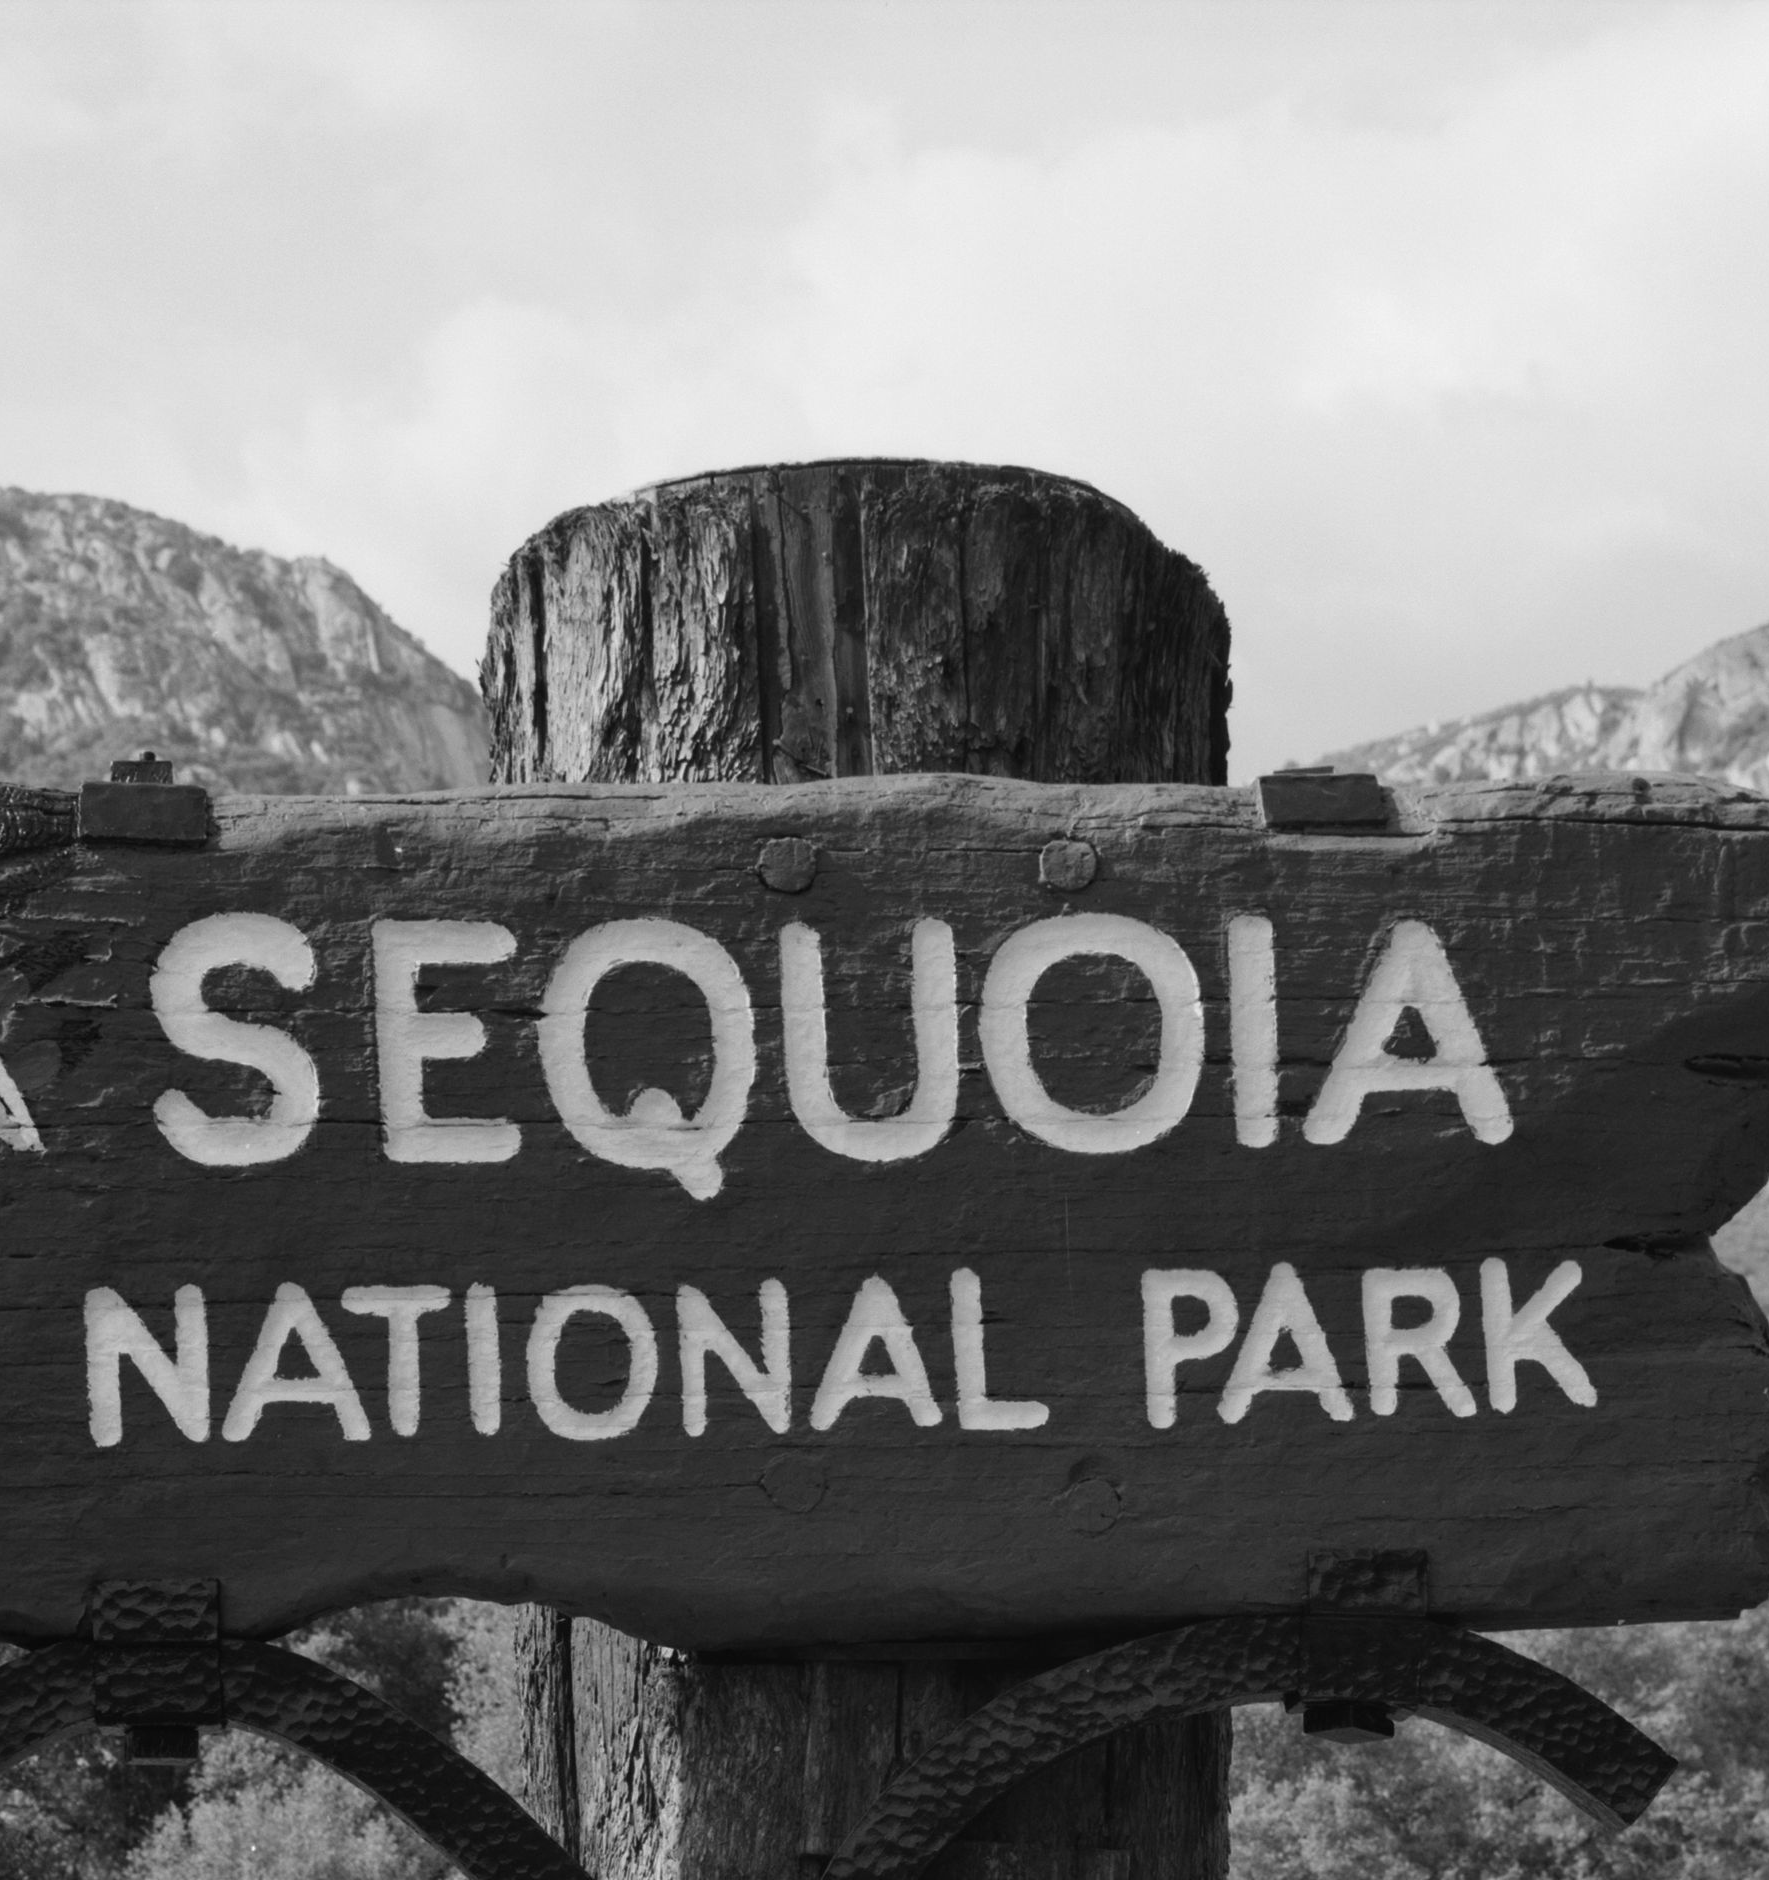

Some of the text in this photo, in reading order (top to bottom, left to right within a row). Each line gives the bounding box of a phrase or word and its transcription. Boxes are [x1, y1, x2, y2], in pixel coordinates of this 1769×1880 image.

[149, 911, 1514, 1202] SEQUOIA
[84, 1256, 1599, 1448] NATIONAL PARK
